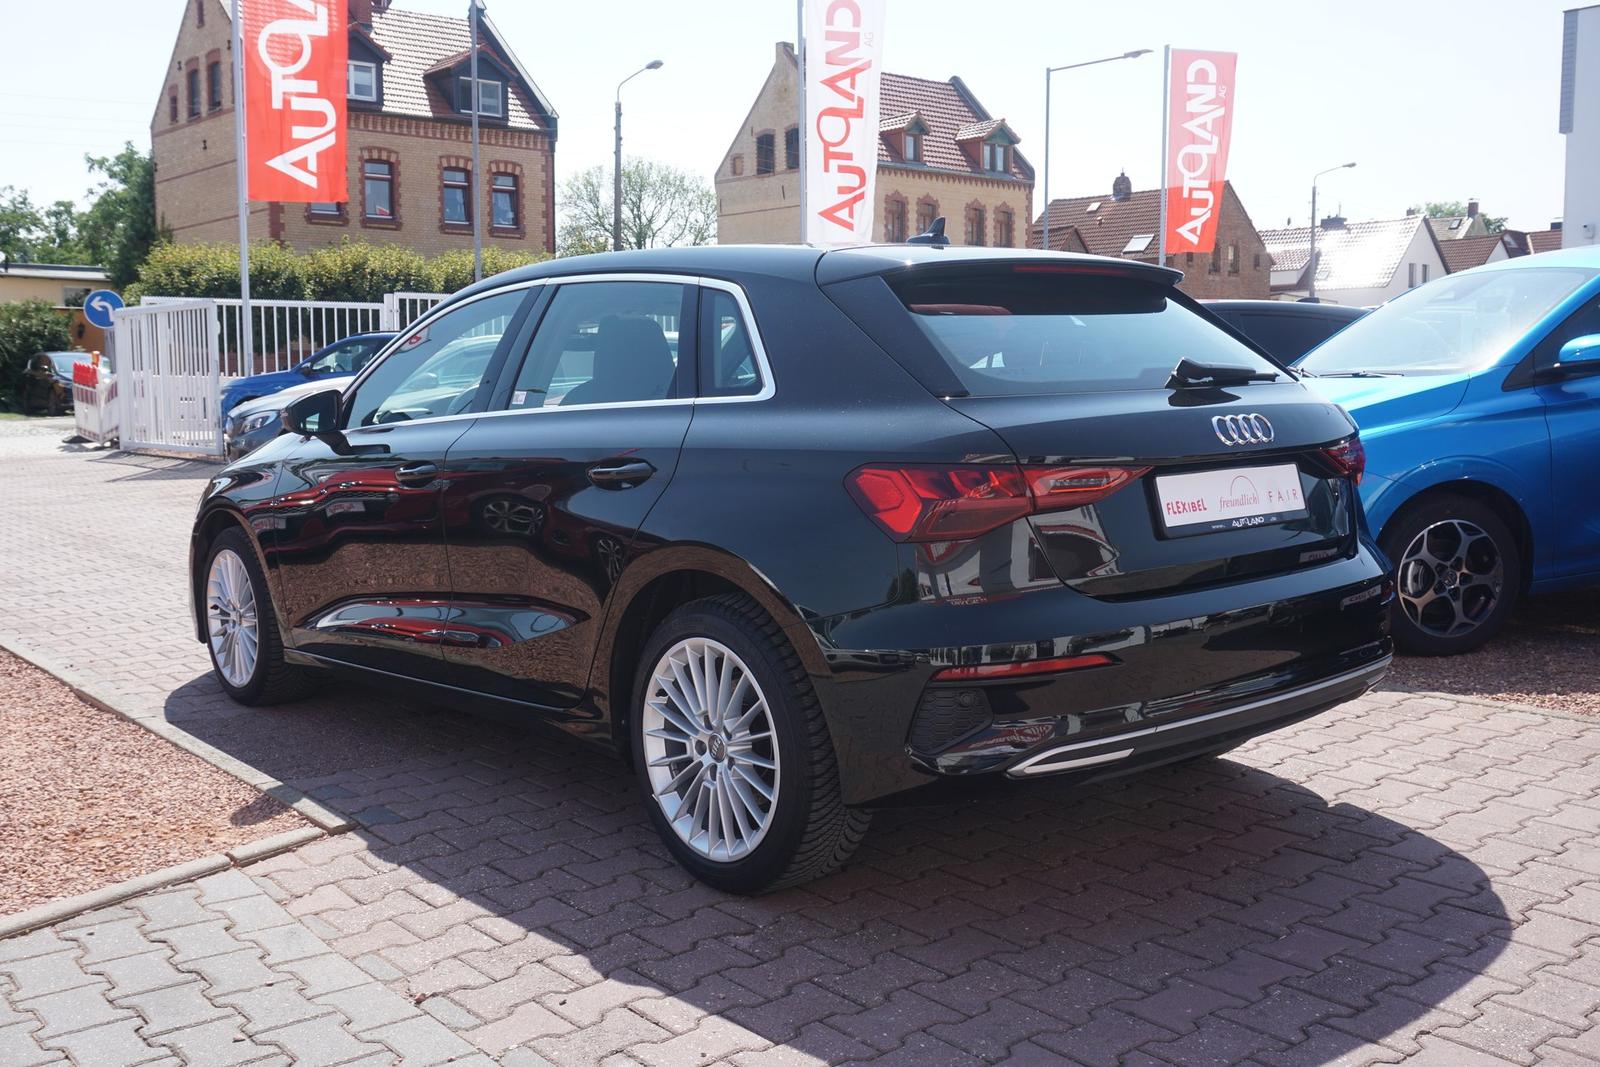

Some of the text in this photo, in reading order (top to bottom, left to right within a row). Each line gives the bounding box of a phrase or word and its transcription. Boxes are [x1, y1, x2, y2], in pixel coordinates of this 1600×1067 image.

[864, 32, 874, 47] AG
[1218, 85, 1227, 98] AG
[816, 0, 872, 231] AUTOLAND
[1175, 59, 1226, 245] AUTOLAND
[1166, 497, 1208, 516] FLEXIBEL
[1219, 493, 1260, 512] freundlich
[1232, 516, 1265, 528] AUTOLAND
